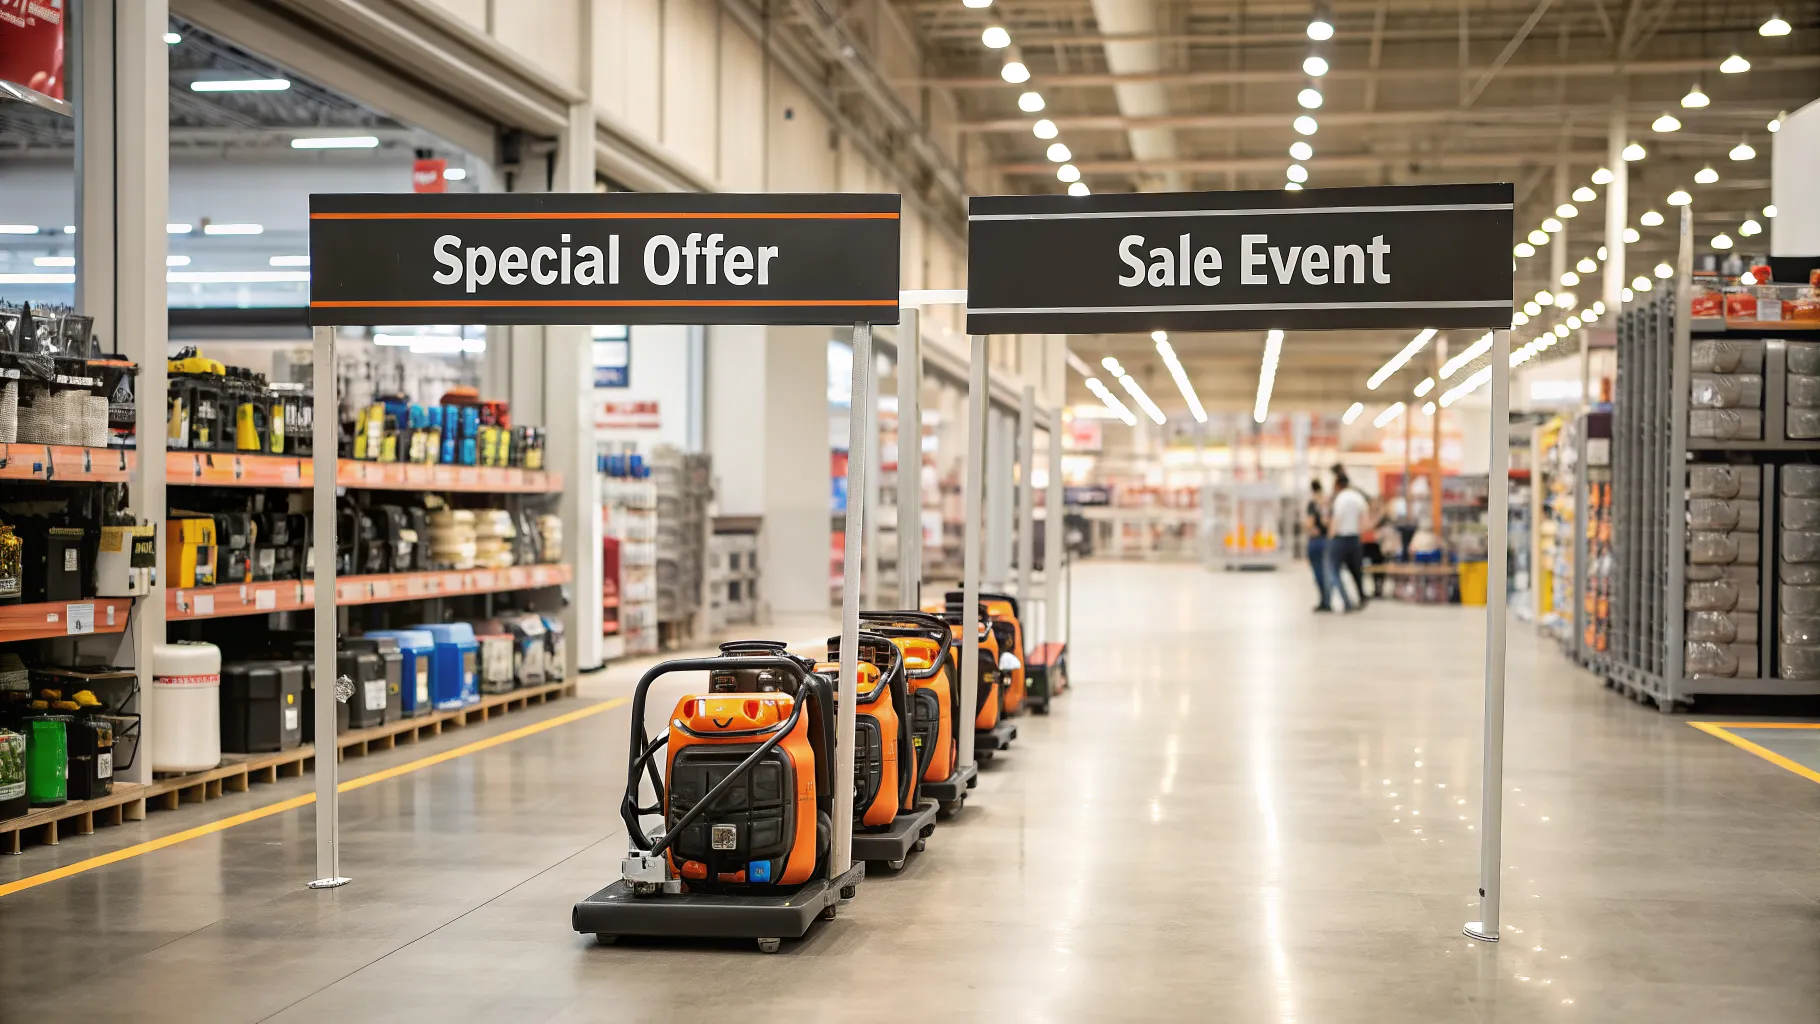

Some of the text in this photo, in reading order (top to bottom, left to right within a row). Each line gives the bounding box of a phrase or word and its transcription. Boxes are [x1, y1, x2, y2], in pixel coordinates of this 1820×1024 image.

[432, 233, 779, 294] Special Offer
[1118, 232, 1391, 288] Sale Event
